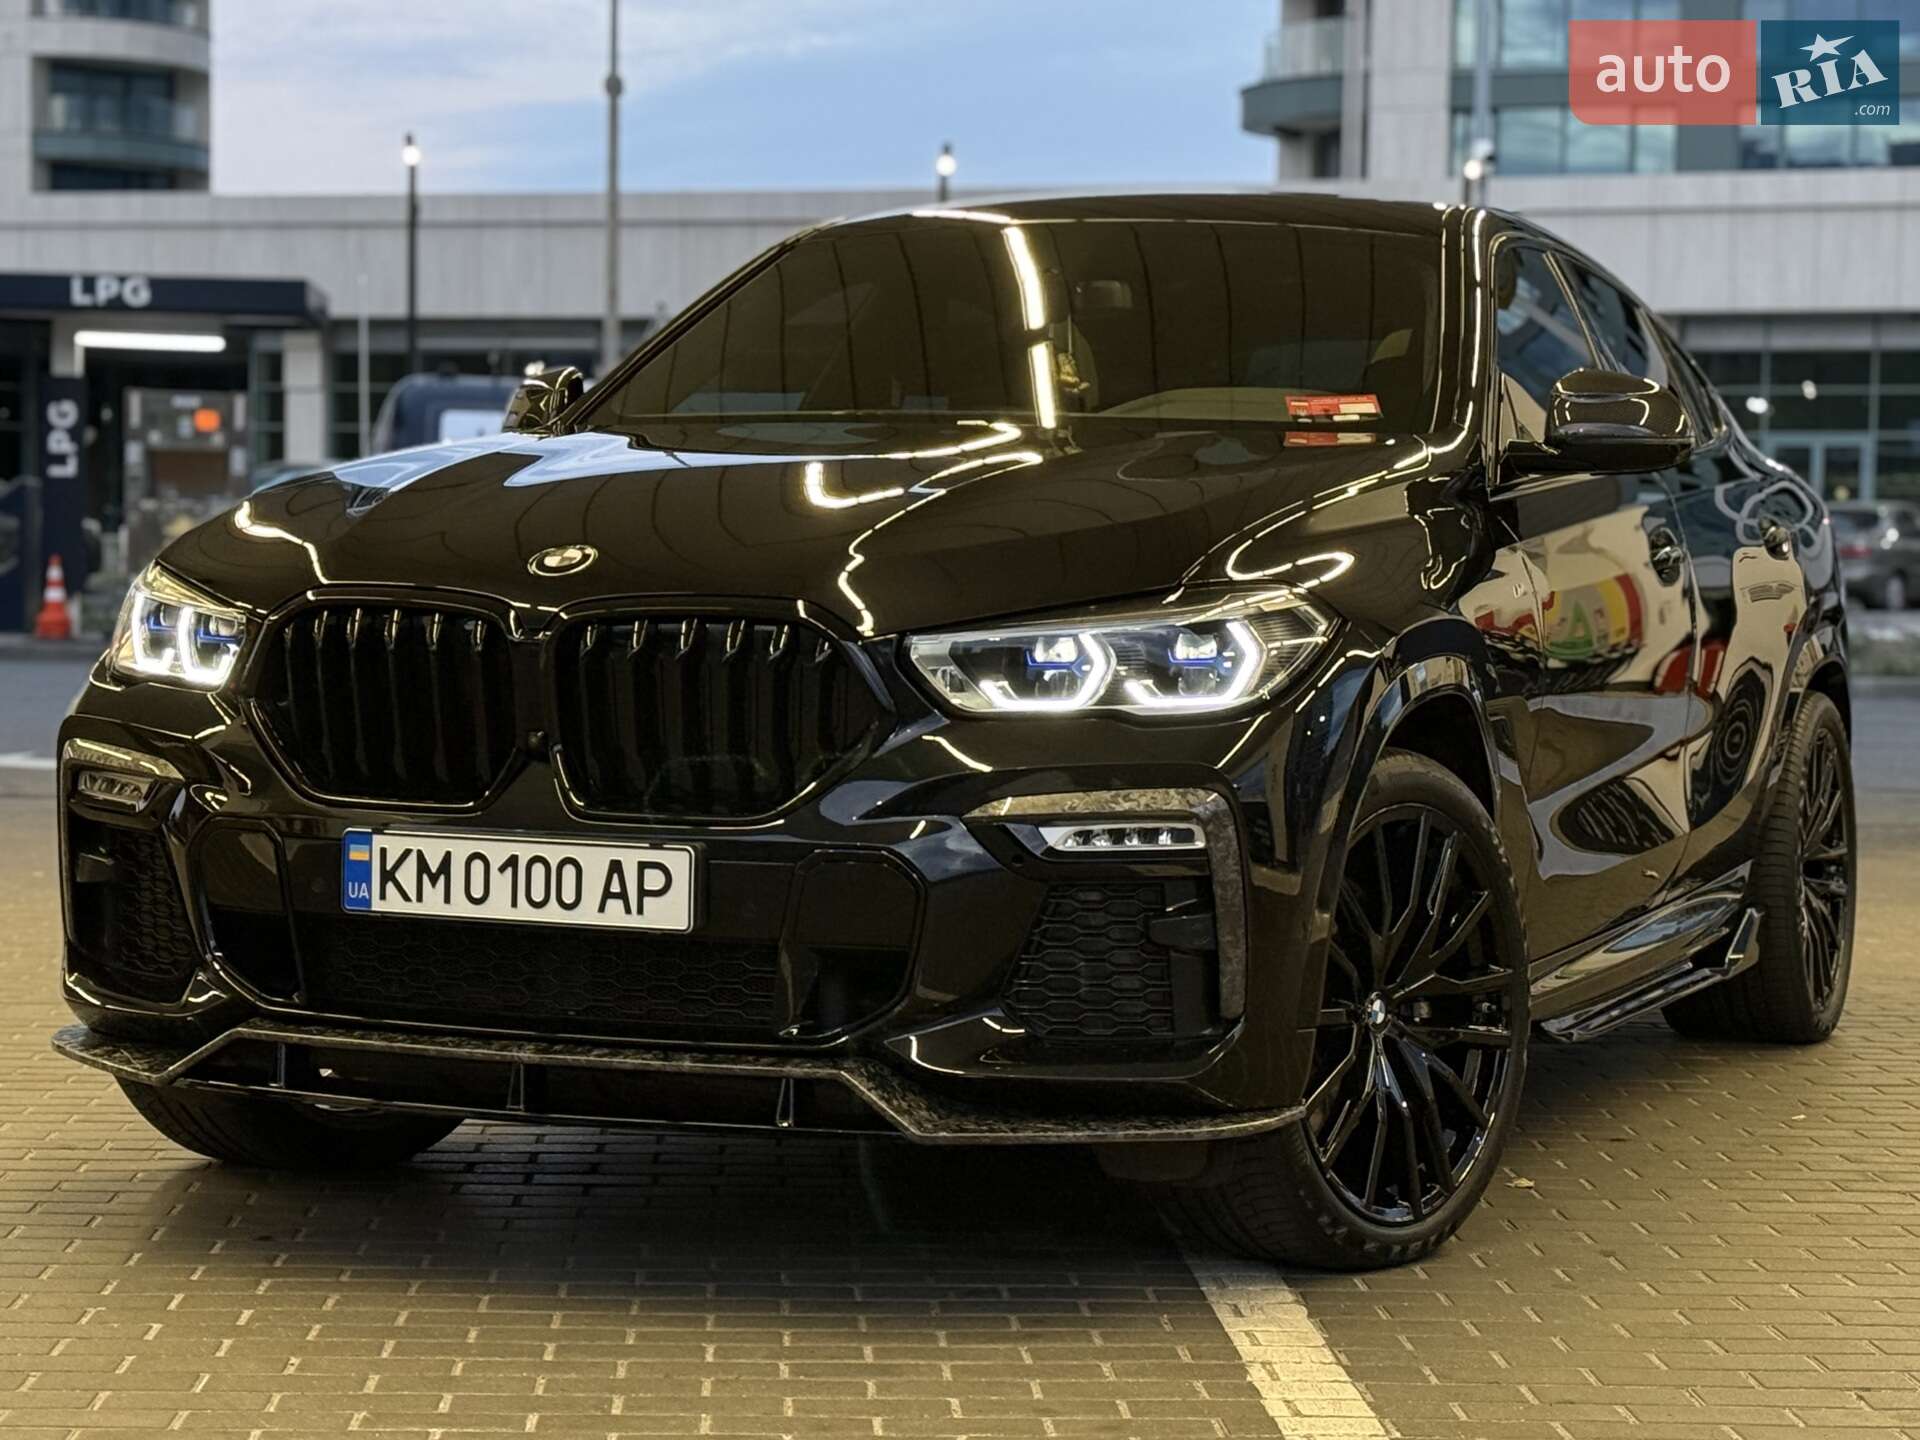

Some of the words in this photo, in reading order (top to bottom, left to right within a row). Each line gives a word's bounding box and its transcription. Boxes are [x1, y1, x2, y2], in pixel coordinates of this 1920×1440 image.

[69, 275, 152, 308] LPG
[46, 399, 79, 478] LPG
[348, 881, 370, 899] UA
[379, 846, 452, 905] KM
[464, 850, 583, 911] 0100
[597, 858, 673, 916] AP
